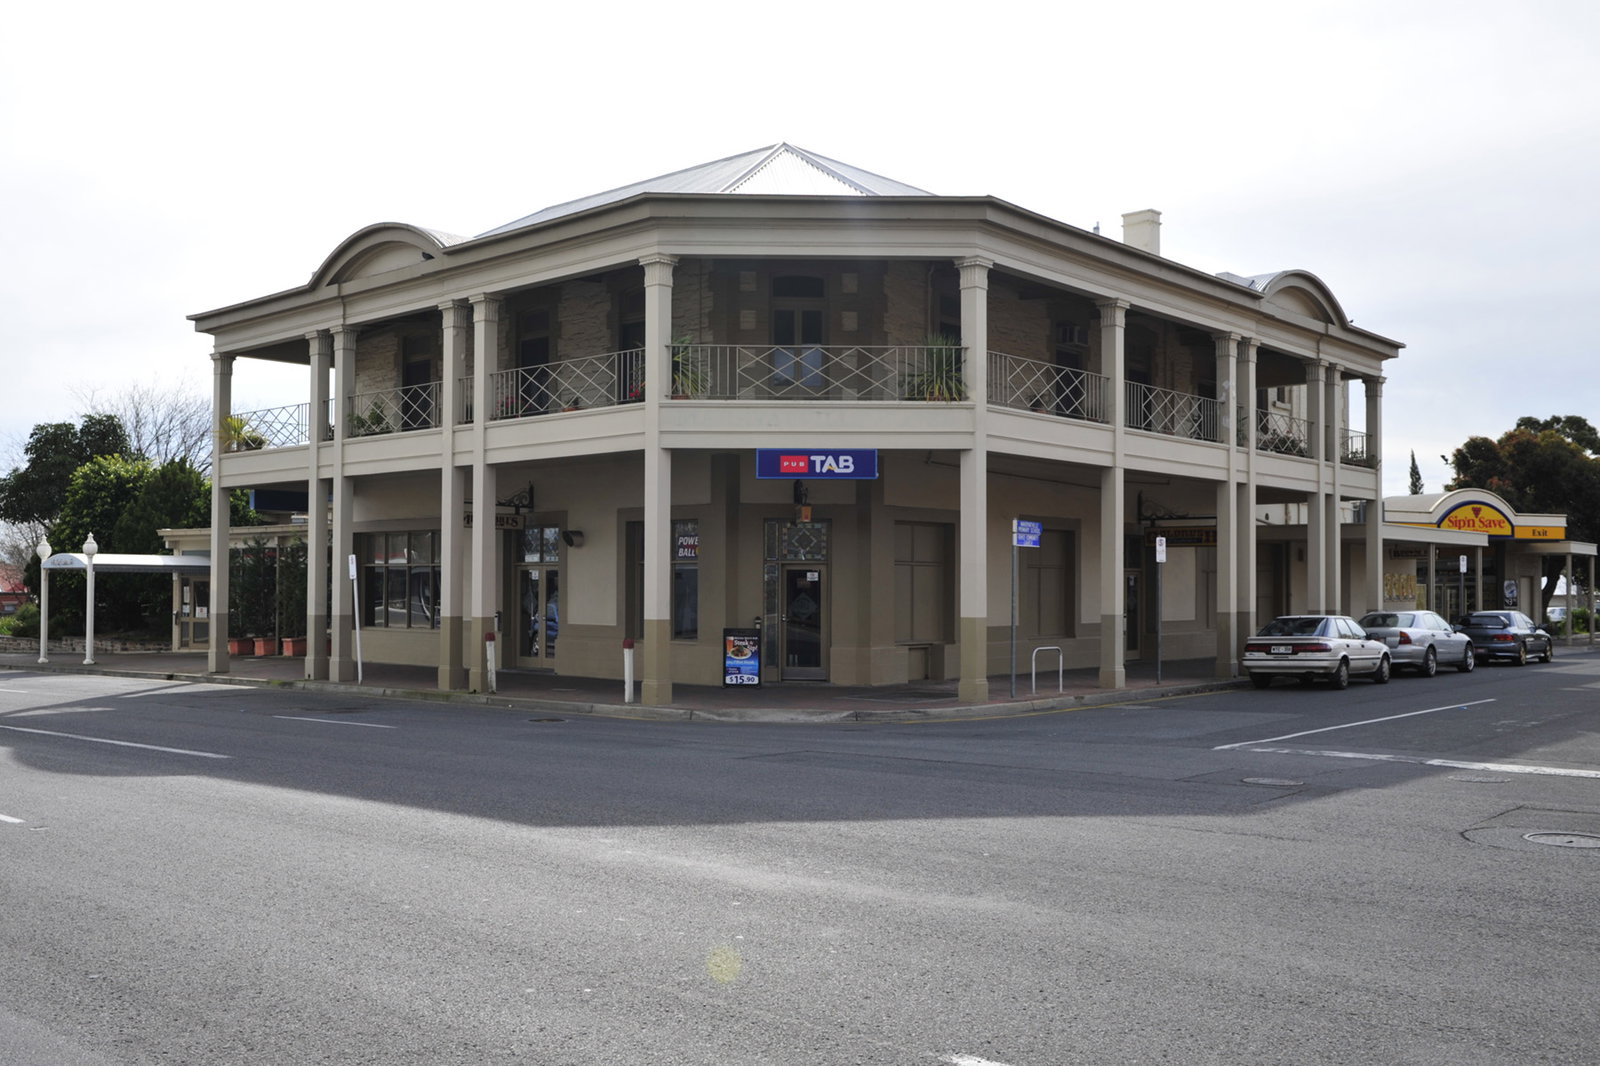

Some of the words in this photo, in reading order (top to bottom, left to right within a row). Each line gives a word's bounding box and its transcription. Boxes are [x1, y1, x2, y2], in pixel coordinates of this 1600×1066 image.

[810, 455, 855, 473] TAB
[1478, 516, 1506, 528] Save
[678, 548, 696, 557] BALL
[729, 676, 755, 684] $15.90
